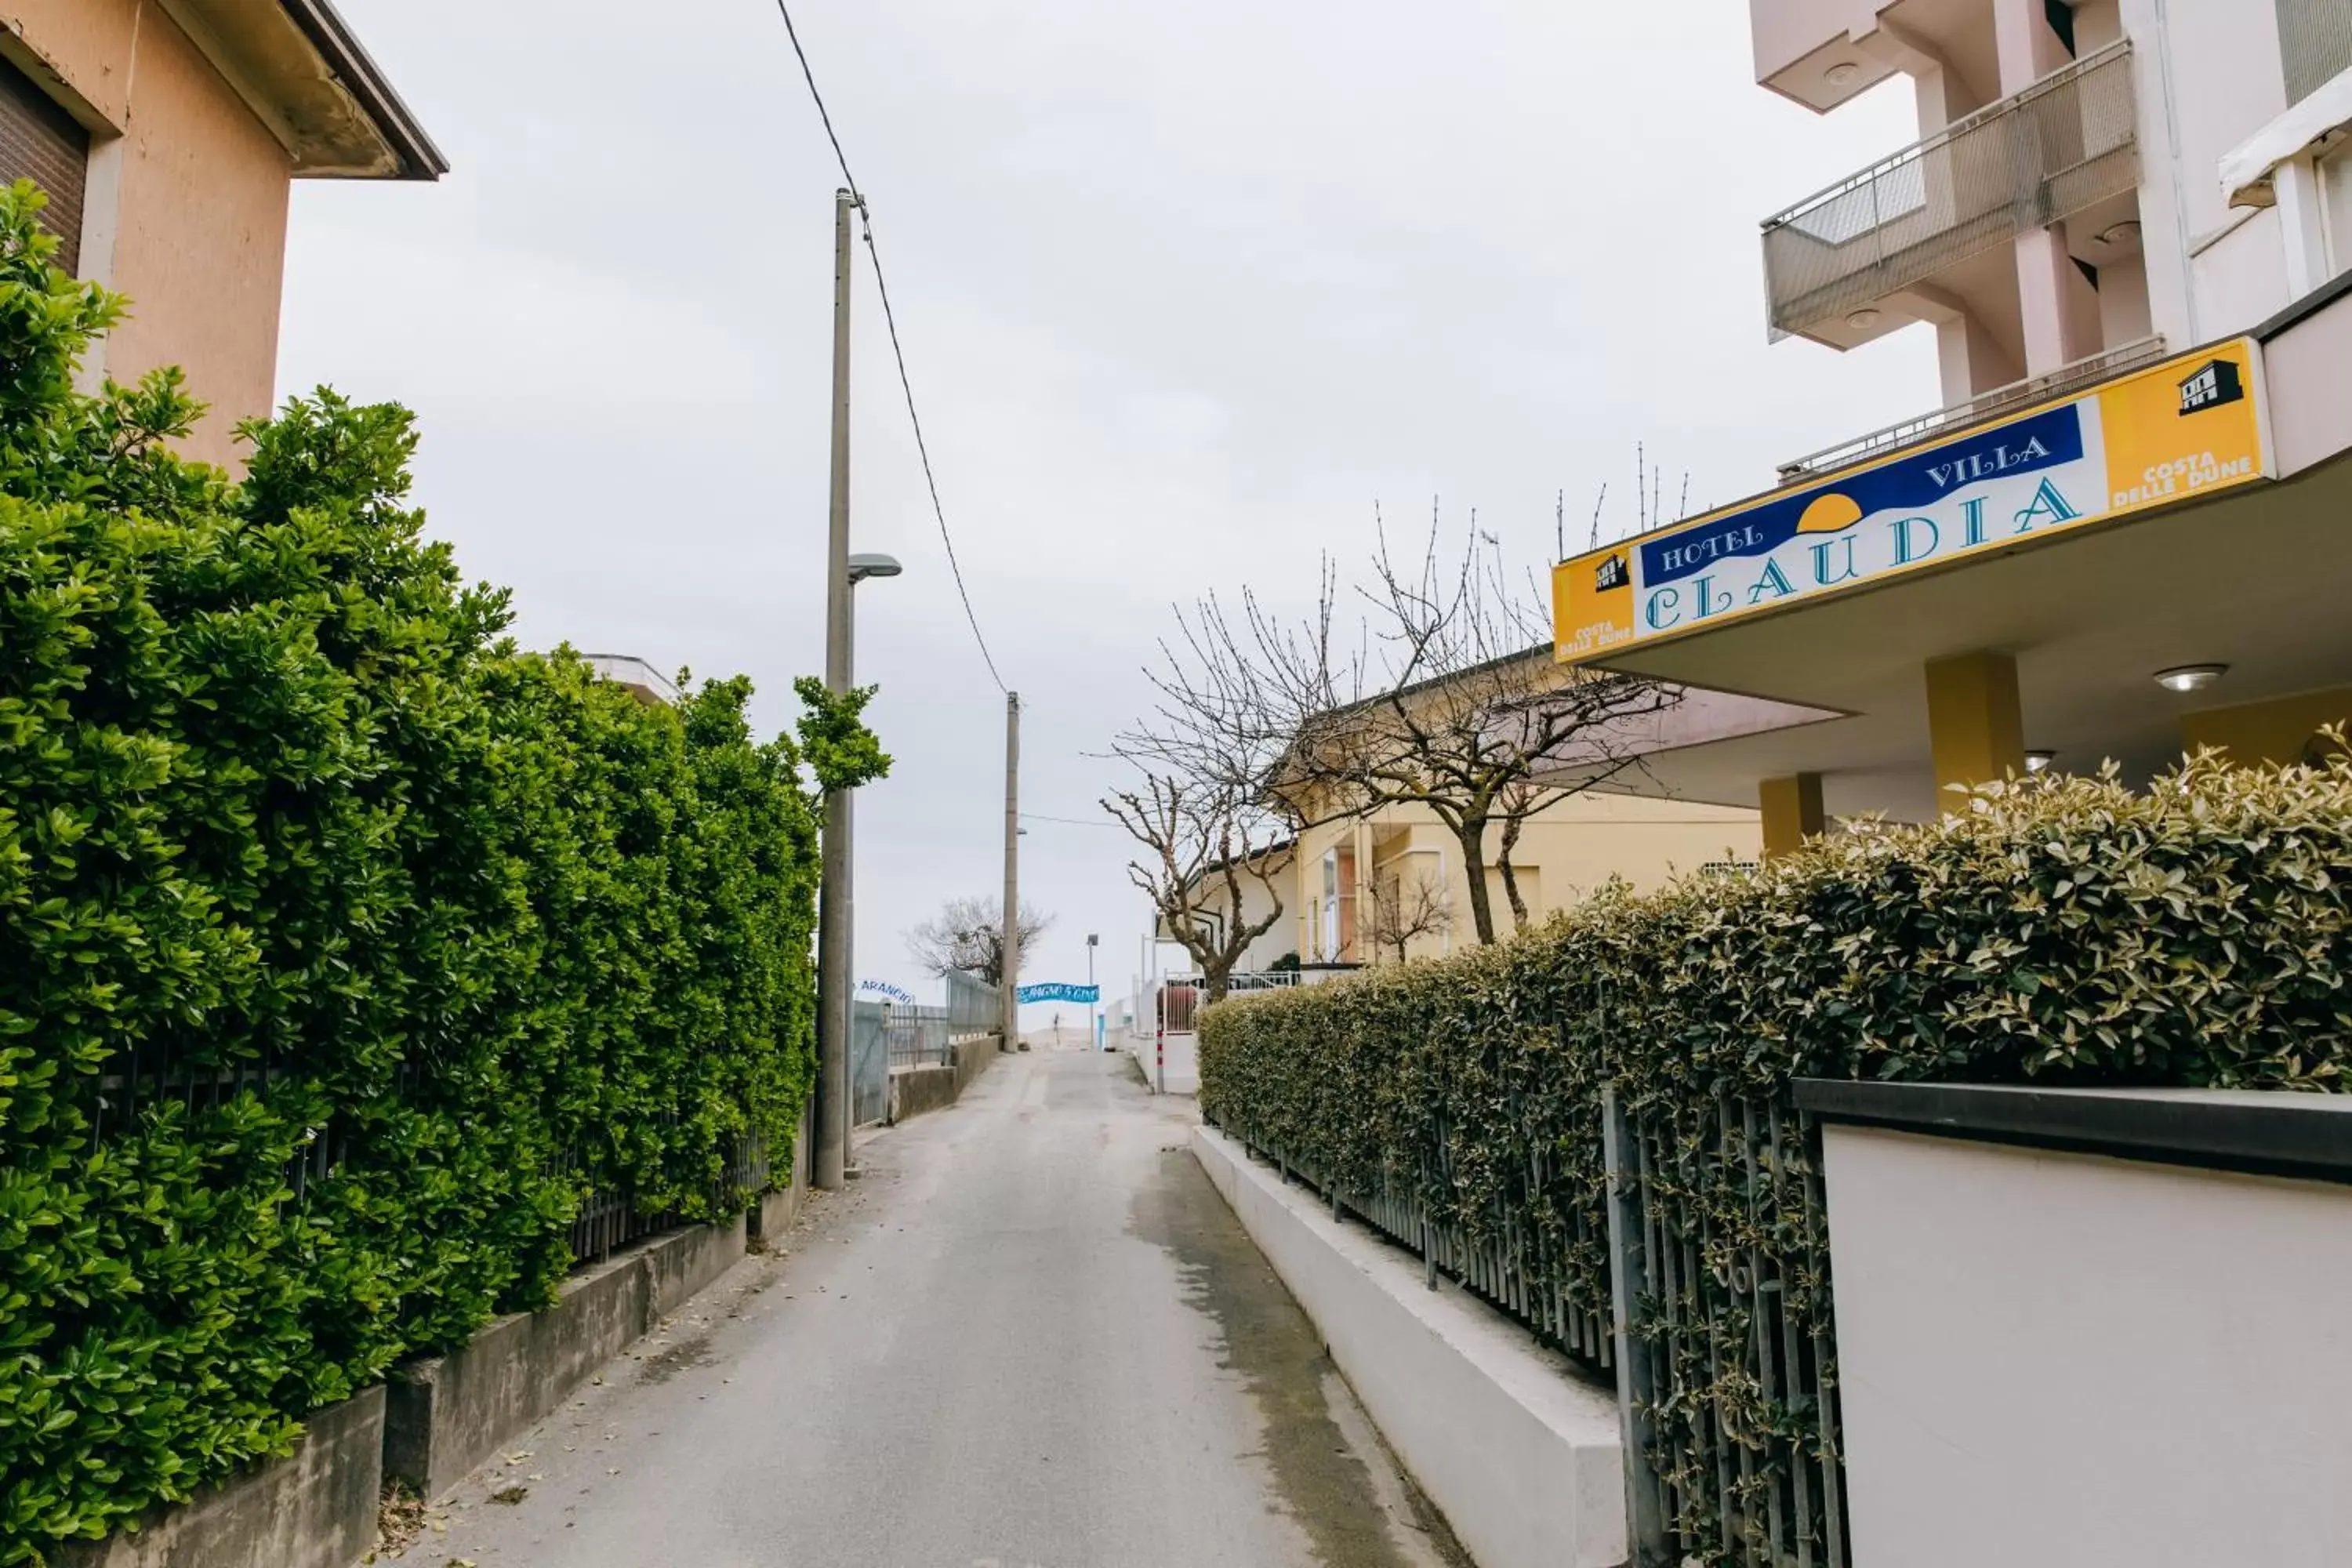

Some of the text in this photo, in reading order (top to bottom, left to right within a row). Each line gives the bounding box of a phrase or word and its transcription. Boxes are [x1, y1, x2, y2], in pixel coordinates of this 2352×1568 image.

[1661, 435, 2050, 572] HOTEL VILLA
[2113, 456, 2252, 508] DELLE DUNE
[2143, 451, 2216, 483] COSTA
[1646, 476, 2082, 630] CLAUDIA
